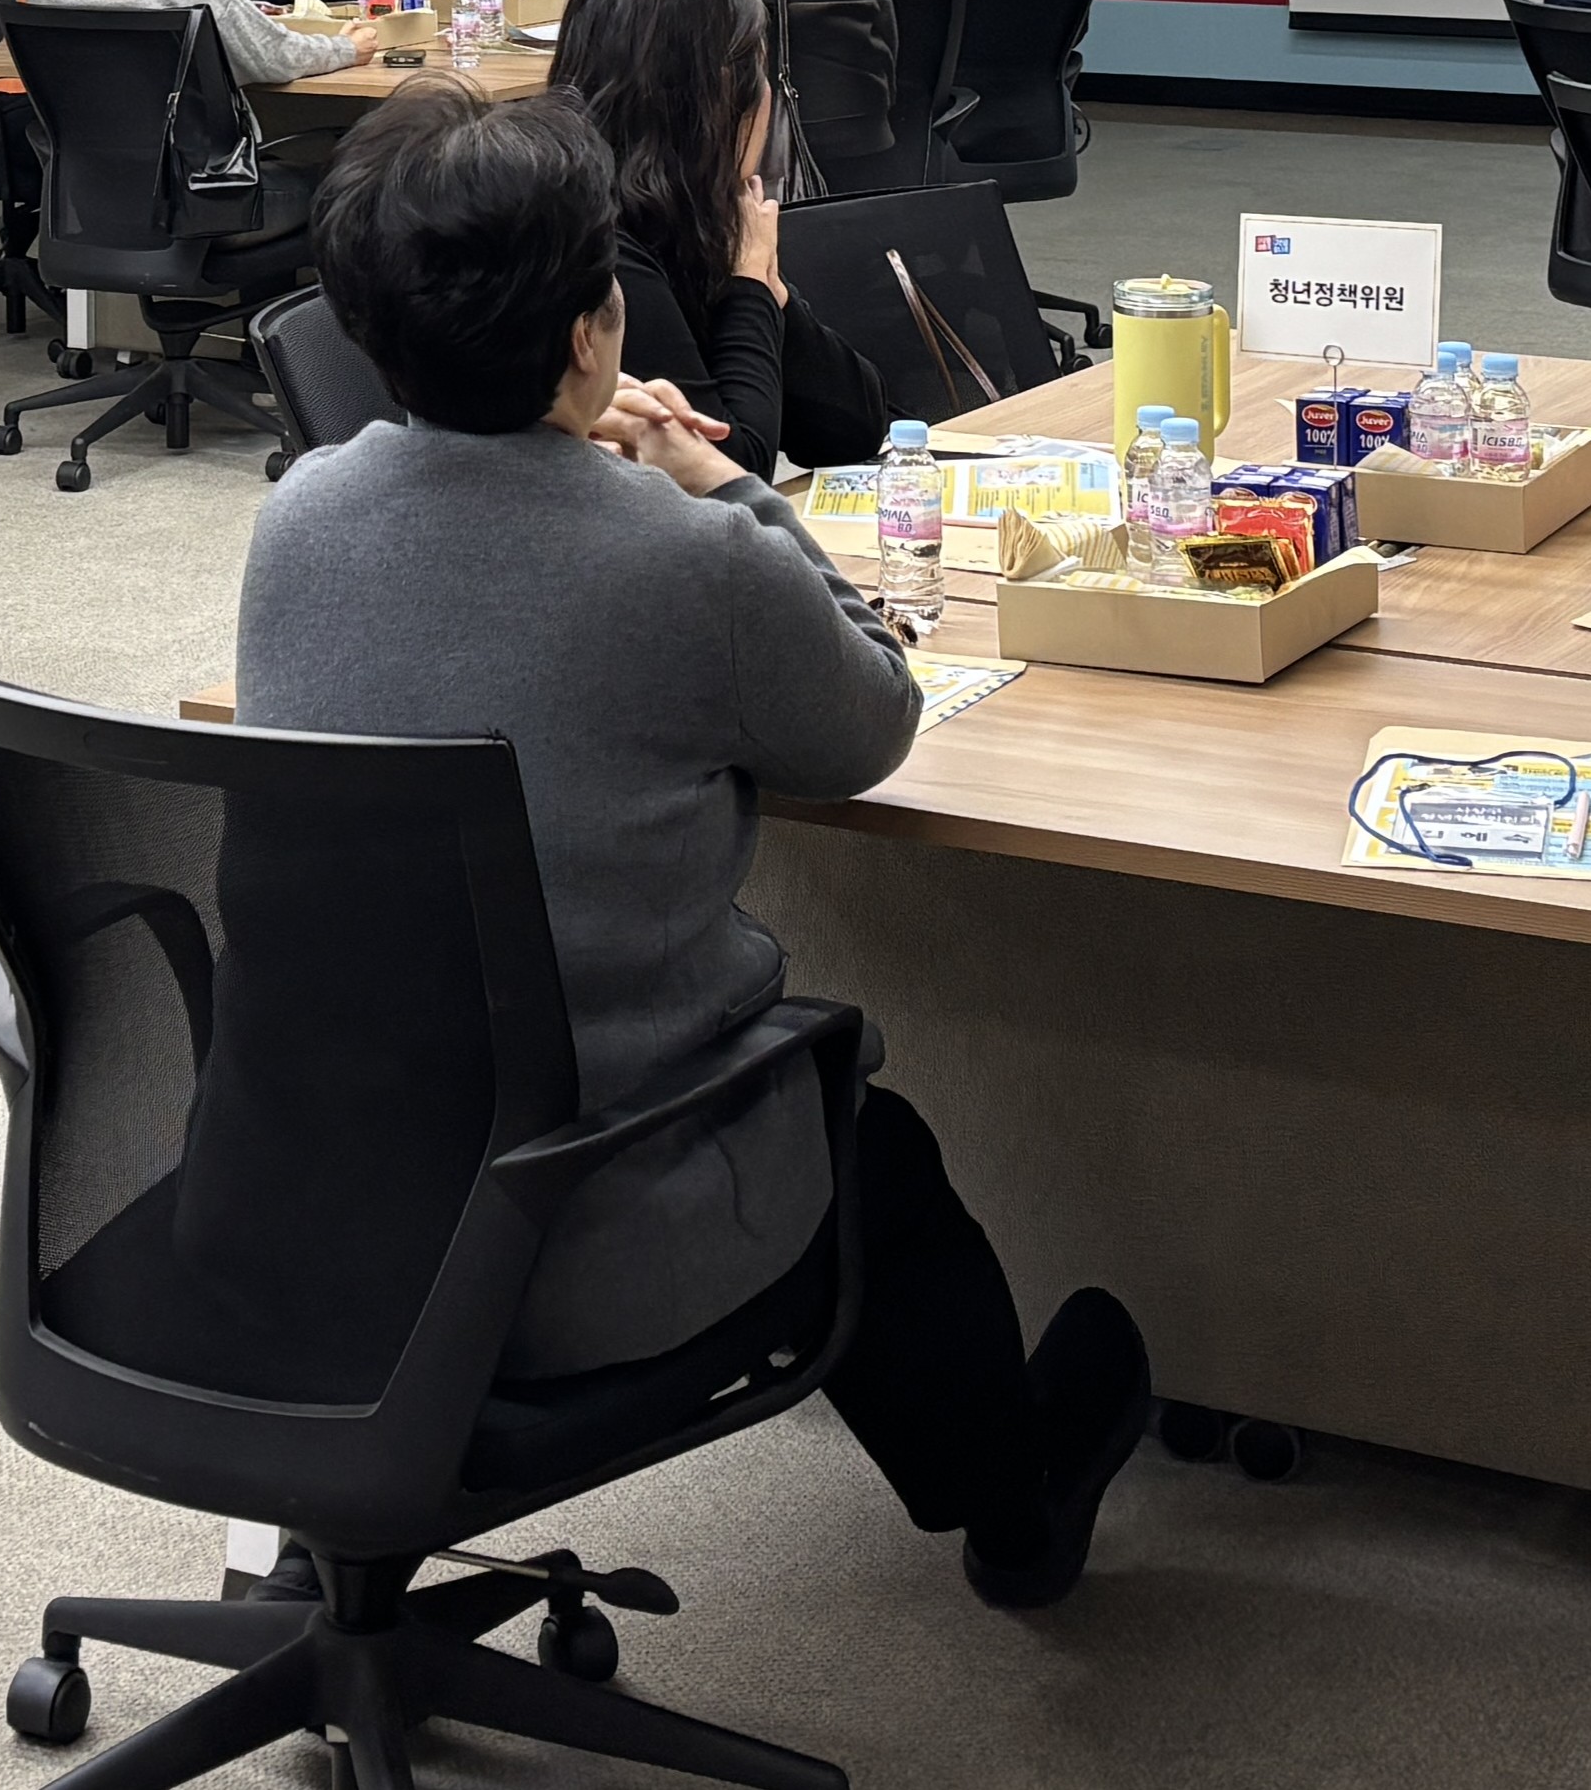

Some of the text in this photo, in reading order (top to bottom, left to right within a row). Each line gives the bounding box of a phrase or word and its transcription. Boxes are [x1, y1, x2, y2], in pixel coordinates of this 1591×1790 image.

[1269, 278, 1404, 312] 청년정책위원
[1305, 409, 1336, 421] Juver
[1360, 415, 1391, 427] Juver
[1305, 428, 1336, 446] 100%
